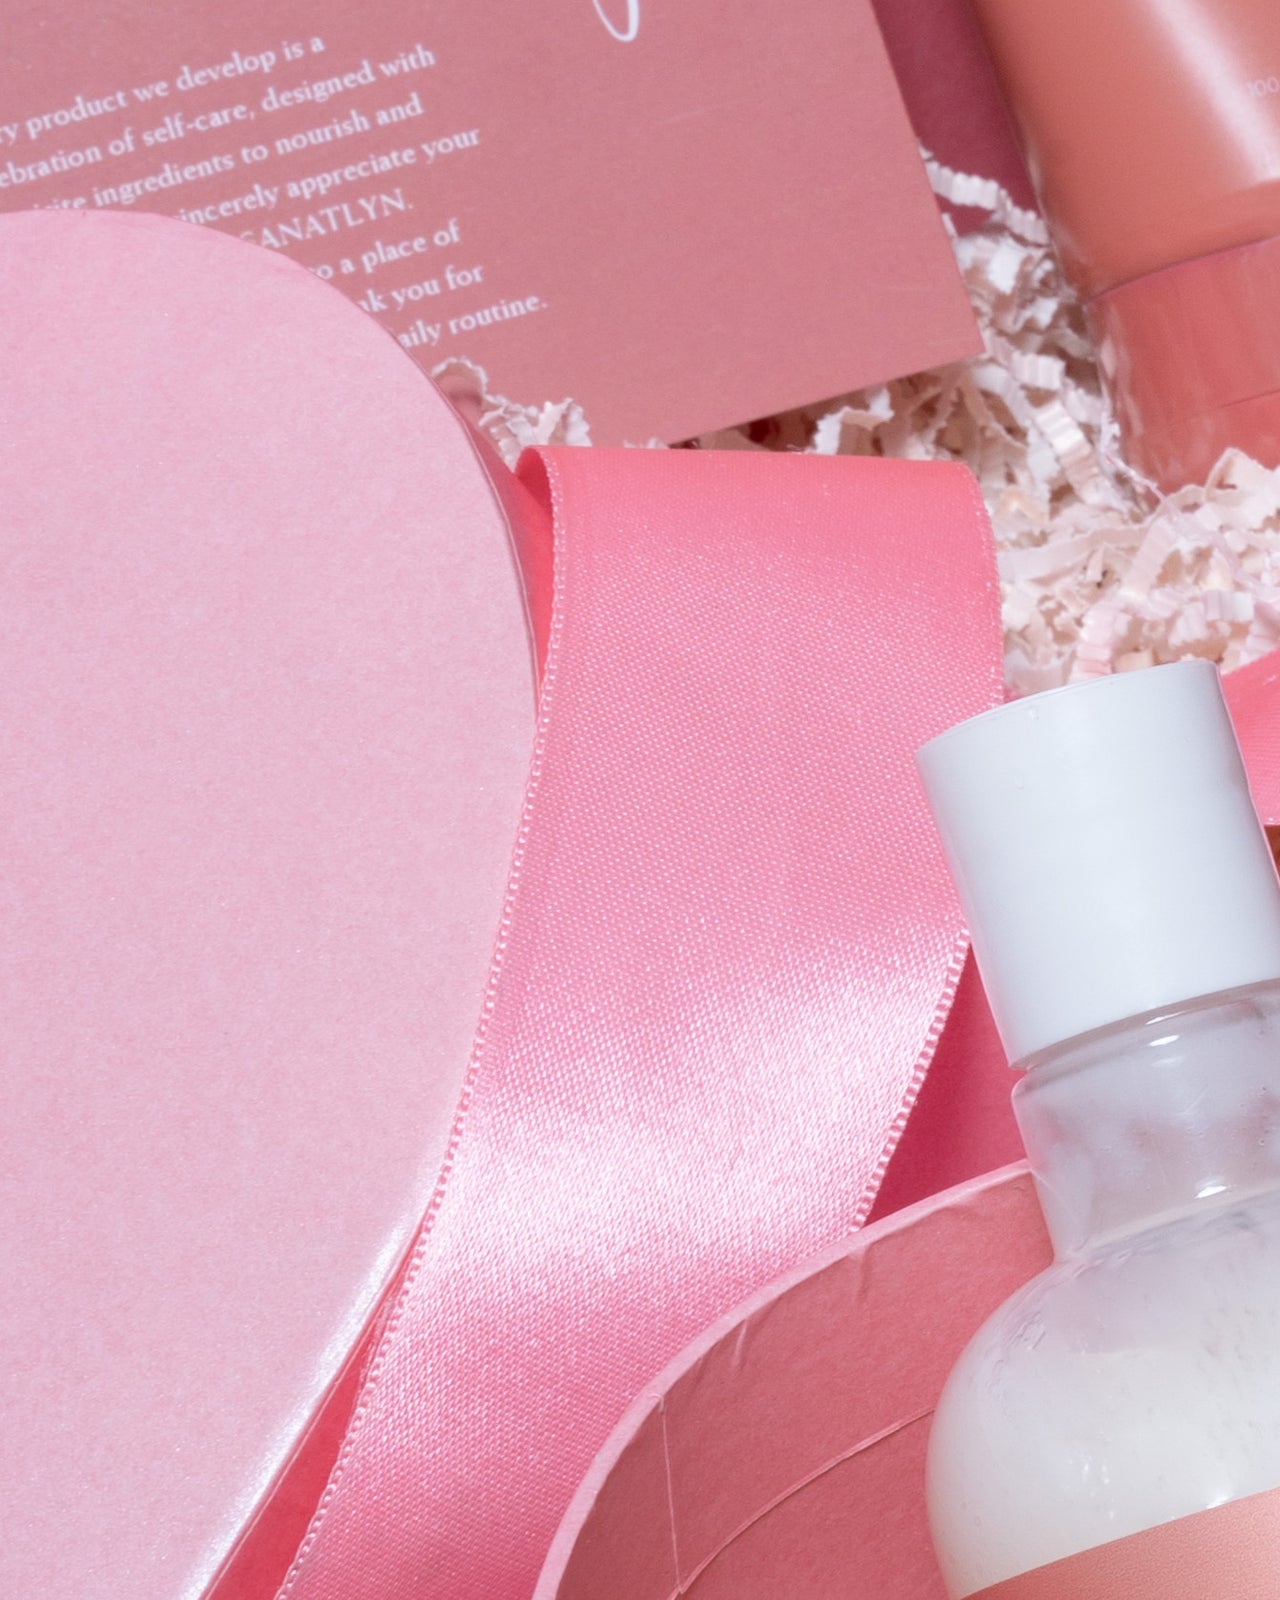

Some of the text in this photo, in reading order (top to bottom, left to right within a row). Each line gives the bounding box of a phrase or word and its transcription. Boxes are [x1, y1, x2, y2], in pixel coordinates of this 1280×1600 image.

[26, 91, 128, 140] product
[133, 81, 169, 102] we
[176, 50, 276, 91] develop
[282, 41, 304, 61] is
[310, 37, 325, 53] a
[108, 127, 135, 156] of
[142, 104, 255, 147] self-care,
[262, 59, 376, 112] designed
[379, 43, 436, 77] with
[94, 91, 424, 207] ingredients to nourish and
[173, 129, 480, 225] incerely appreciate your
[340, 258, 355, 274] a
[361, 236, 427, 274] place
[434, 217, 461, 248] of
[391, 278, 441, 311] you
[445, 265, 484, 291] for
[449, 295, 549, 335] routine.
